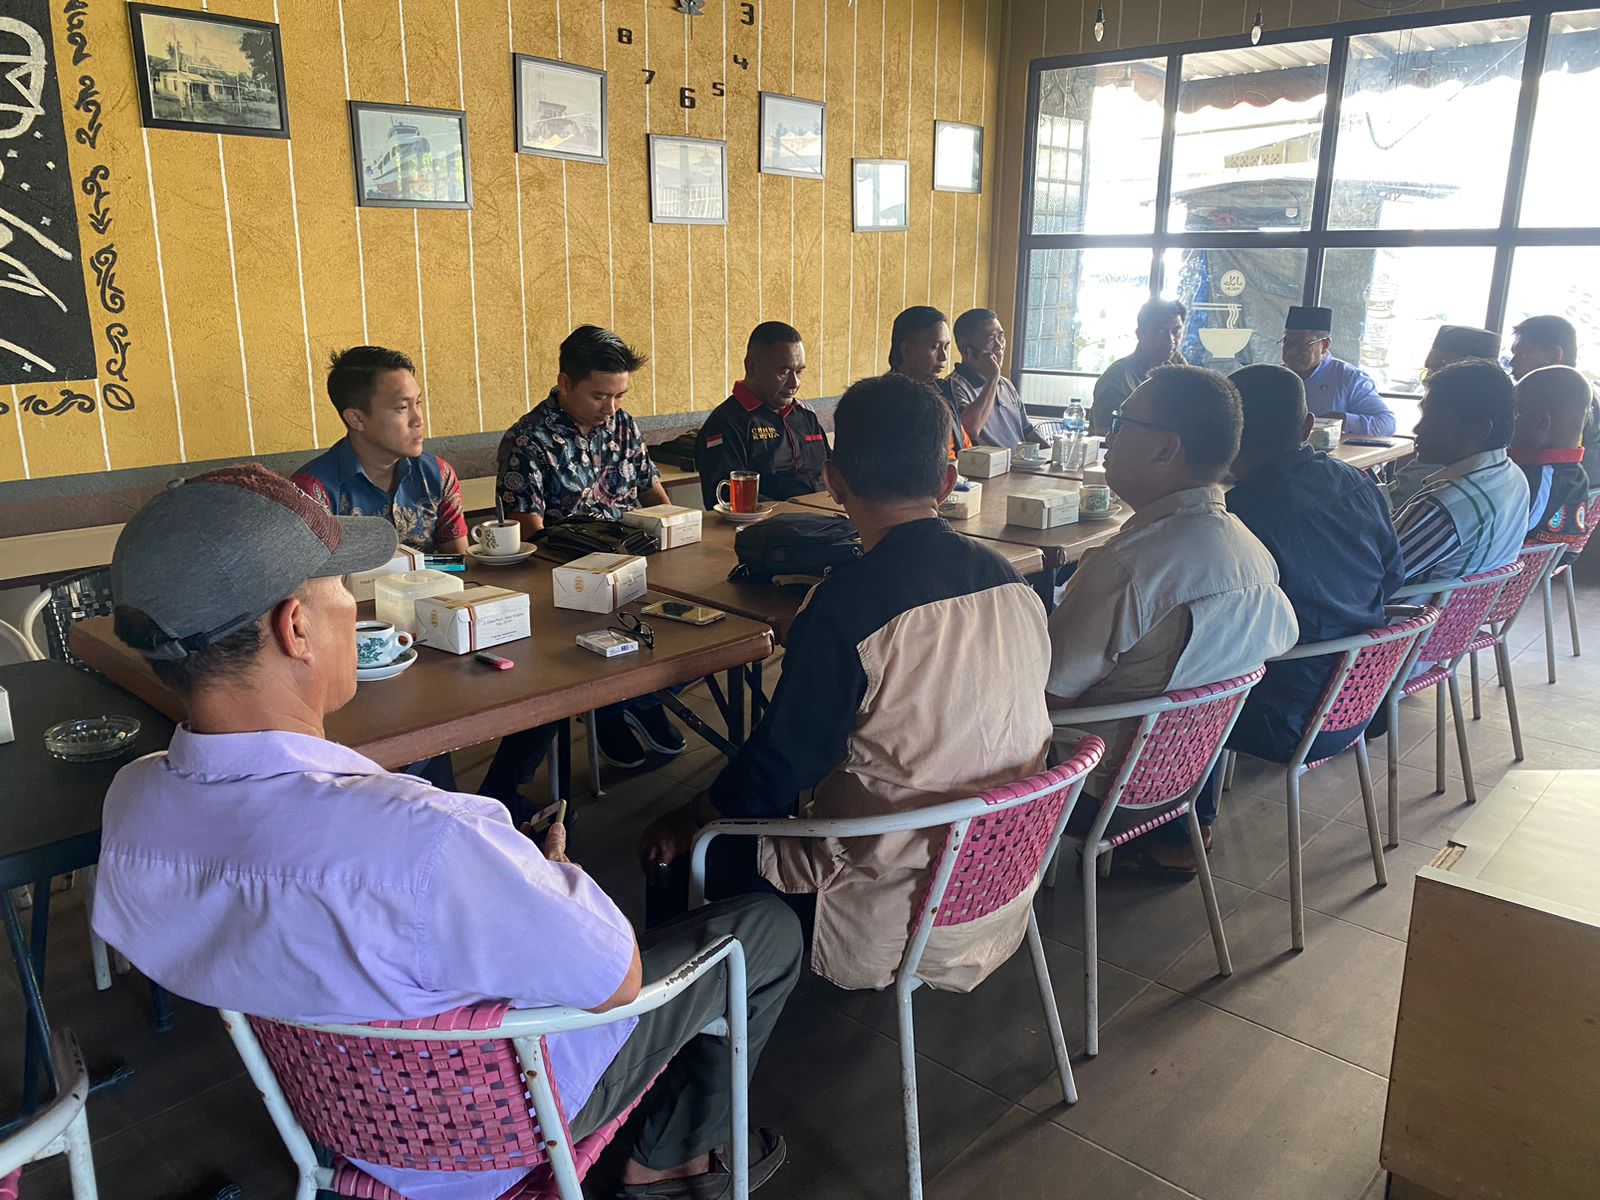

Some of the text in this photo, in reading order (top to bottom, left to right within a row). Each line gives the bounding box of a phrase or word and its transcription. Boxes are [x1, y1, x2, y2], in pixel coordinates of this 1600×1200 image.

[740, 2, 755, 26] 3
[617, 27, 633, 45] 8
[733, 54, 749, 70] 4
[641, 68, 656, 85] 7
[679, 86, 696, 109] 6
[712, 81, 725, 97] 5
